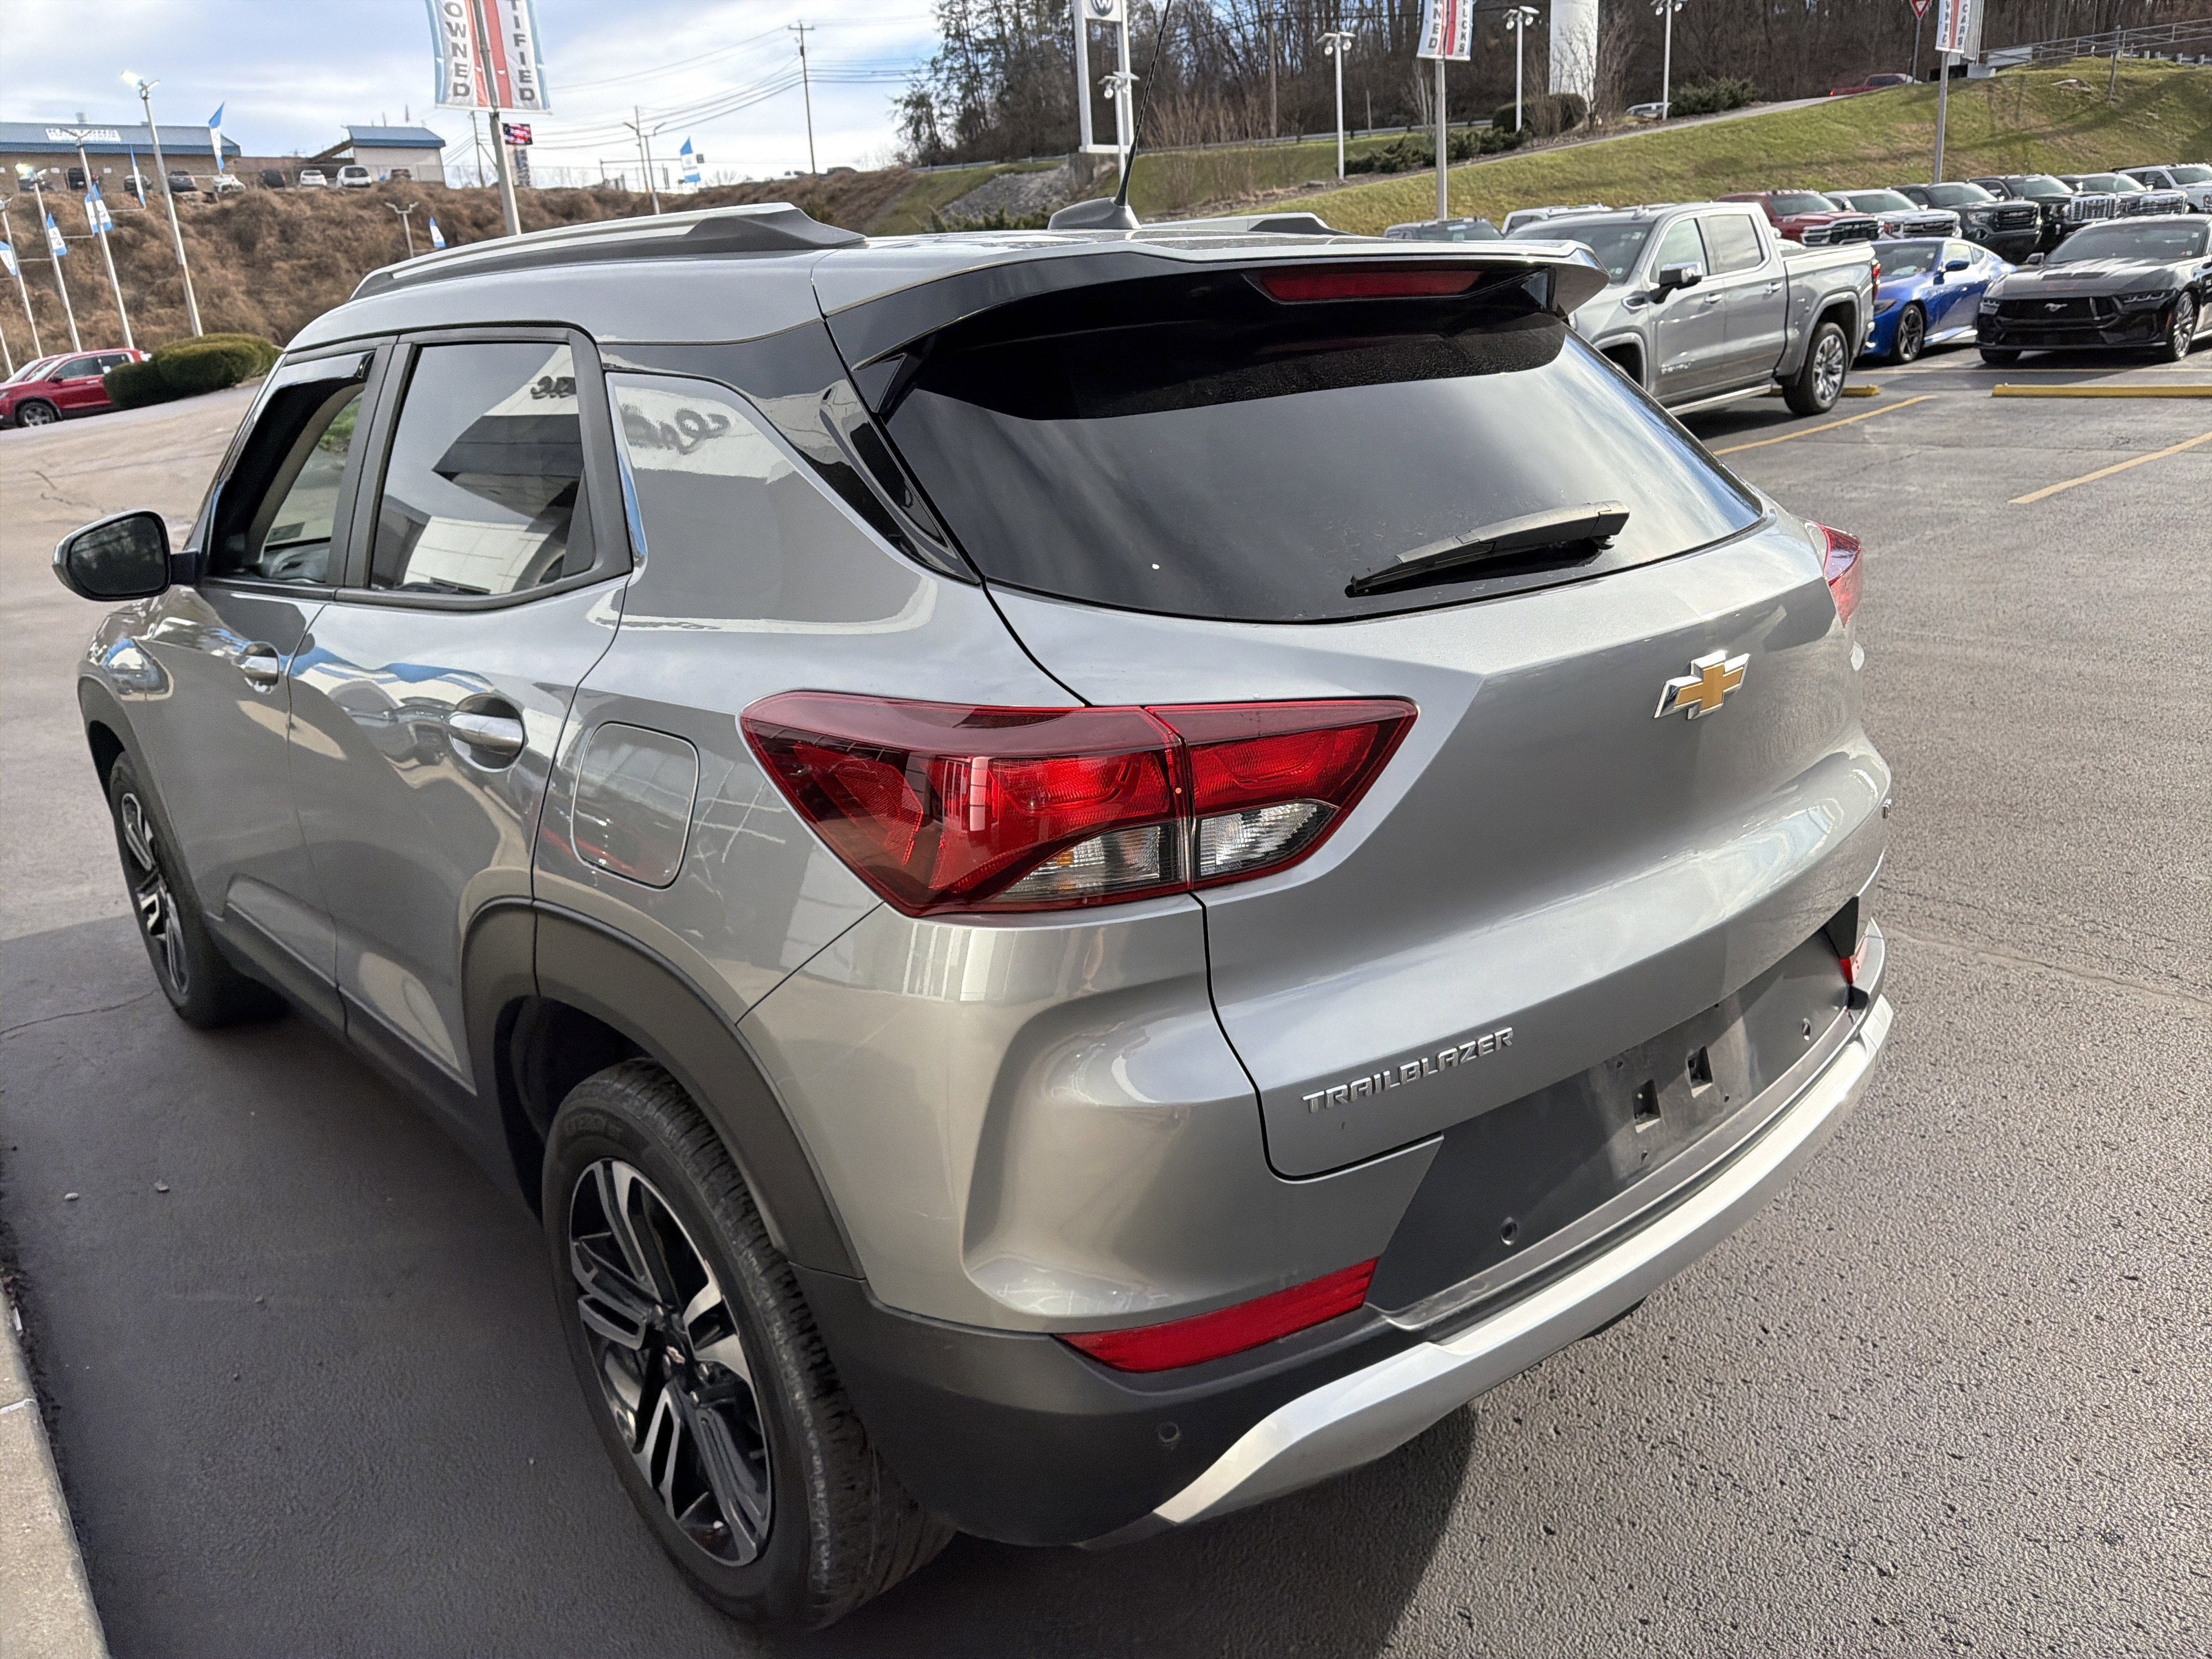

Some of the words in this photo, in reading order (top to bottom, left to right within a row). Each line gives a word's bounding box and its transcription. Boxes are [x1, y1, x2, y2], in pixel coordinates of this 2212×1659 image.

[444, 2, 470, 97] OWNED
[1957, 3, 1968, 46] CARS
[1301, 1026, 1514, 1114] TRAILBLAZER
